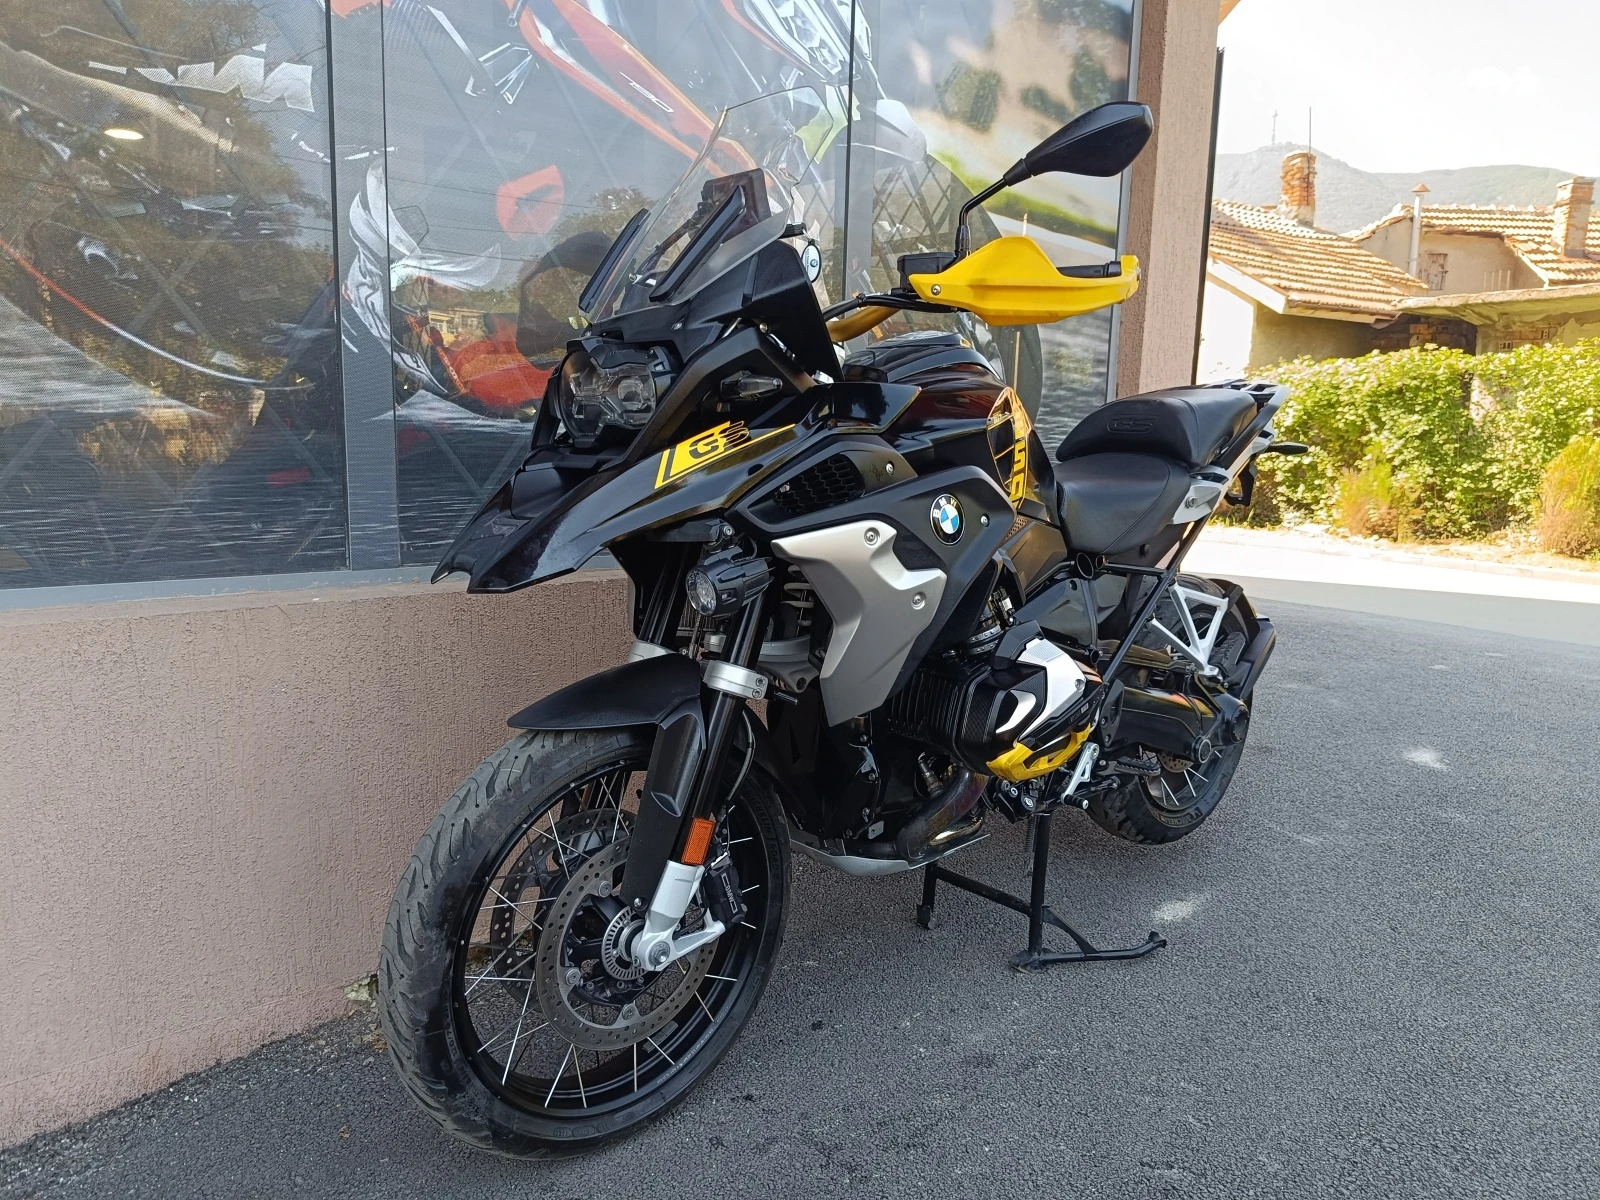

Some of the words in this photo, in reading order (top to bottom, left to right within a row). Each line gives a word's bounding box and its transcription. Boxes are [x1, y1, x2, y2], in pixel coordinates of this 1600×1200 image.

[1108, 415, 1155, 433] GS
[689, 420, 750, 459] GS
[932, 496, 958, 519] BMW
[725, 885, 736, 903] BMW
